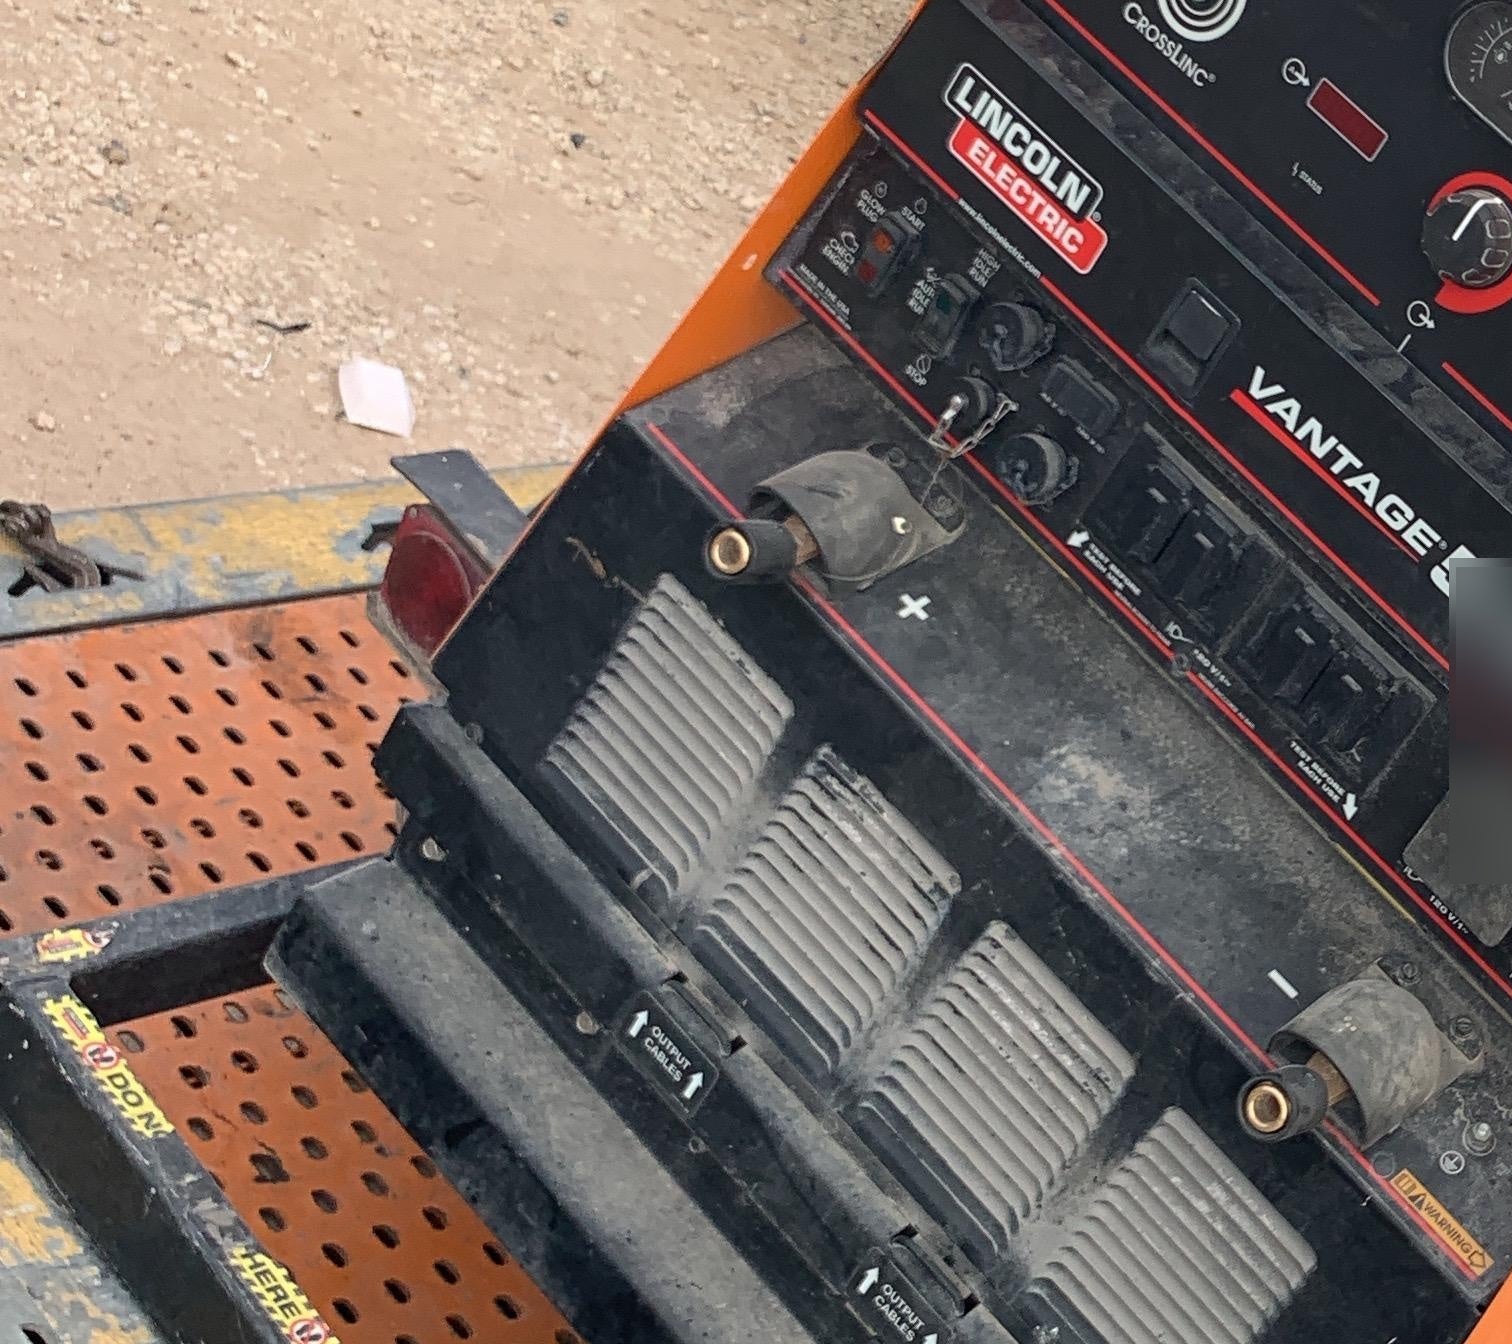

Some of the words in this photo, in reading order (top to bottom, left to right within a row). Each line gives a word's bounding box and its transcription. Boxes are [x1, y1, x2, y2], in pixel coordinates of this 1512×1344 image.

[953, 75, 1091, 214] LINCOLN
[856, 199, 879, 224] PLUG
[860, 189, 888, 216] GLOW
[901, 206, 927, 233] START
[966, 139, 1085, 255] ELECTRIC
[957, 197, 1043, 280] www.lincolnelectric.com
[977, 246, 1001, 273] HIGH
[967, 267, 989, 289] RUN
[904, 364, 929, 387] STOP
[1247, 365, 1442, 557] VANTAGE
[1290, 740, 1312, 762] TEST
[1311, 762, 1346, 797] BEFORE
[1297, 759, 1322, 785] EACH
[1321, 783, 1341, 803] USE
[643, 1037, 683, 1082] CABLES
[652, 1025, 692, 1070] OUTPUT
[107, 1072, 144, 1107] DO
[1424, 1200, 1474, 1255] WARNING
[247, 1253, 301, 1320] HERE
[882, 1284, 926, 1330] OUTPUT
[874, 1295, 916, 1342] CABLES
